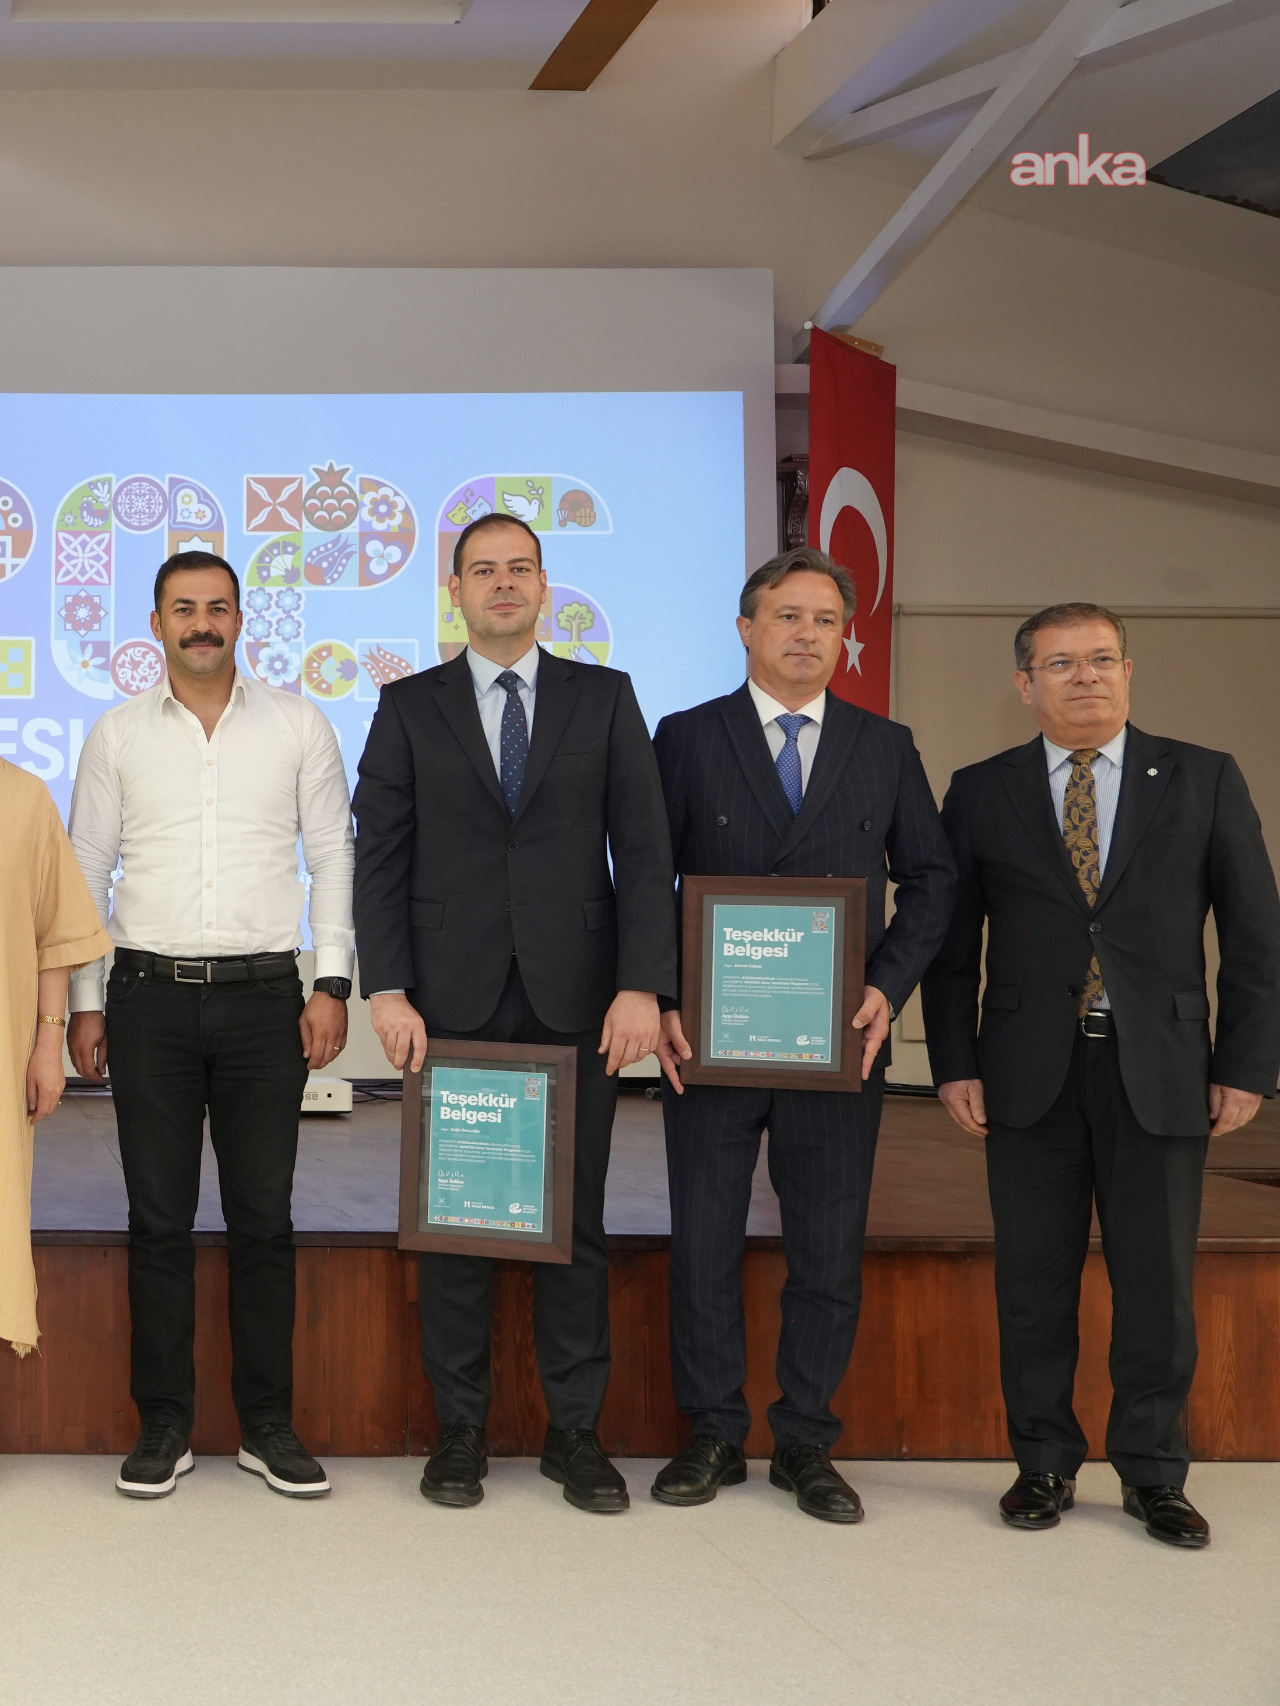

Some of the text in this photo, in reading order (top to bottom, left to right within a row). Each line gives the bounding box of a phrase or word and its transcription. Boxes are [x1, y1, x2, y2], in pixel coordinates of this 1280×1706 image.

[723, 927, 805, 943] Teşekkür
[723, 943, 789, 960] Belgesi
[440, 1091, 517, 1108] Teşekkür
[440, 1106, 502, 1124] Belgesi
